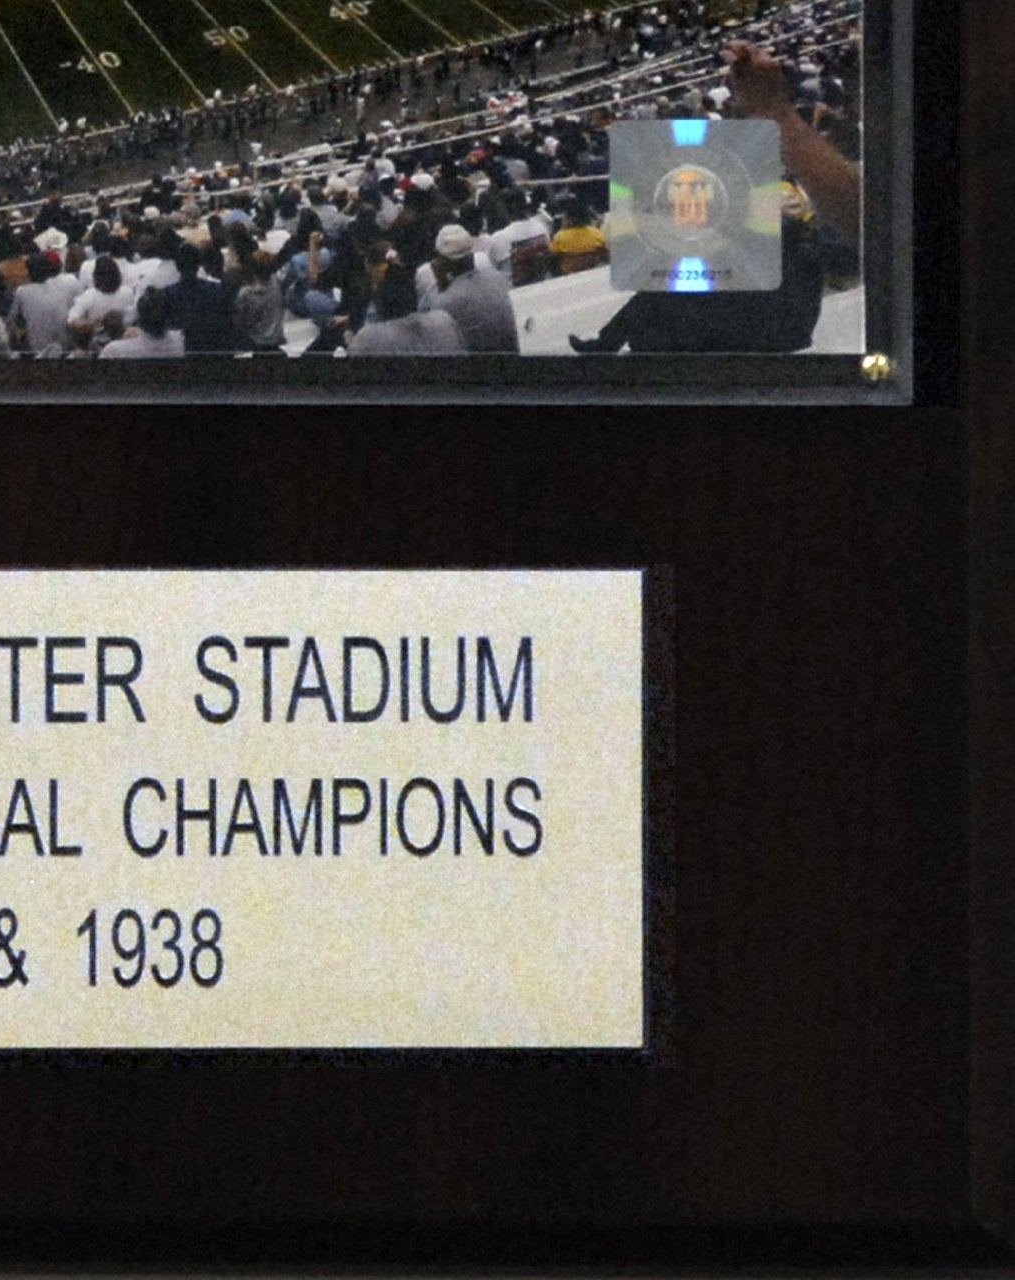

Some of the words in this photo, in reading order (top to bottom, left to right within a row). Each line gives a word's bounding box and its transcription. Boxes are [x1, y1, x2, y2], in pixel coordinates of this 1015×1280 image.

[203, 25, 250, 47] 50
[195, 636, 533, 724] STADIUM
[124, 777, 543, 857] CHAMPIONS
[77, 909, 223, 988] 1938
